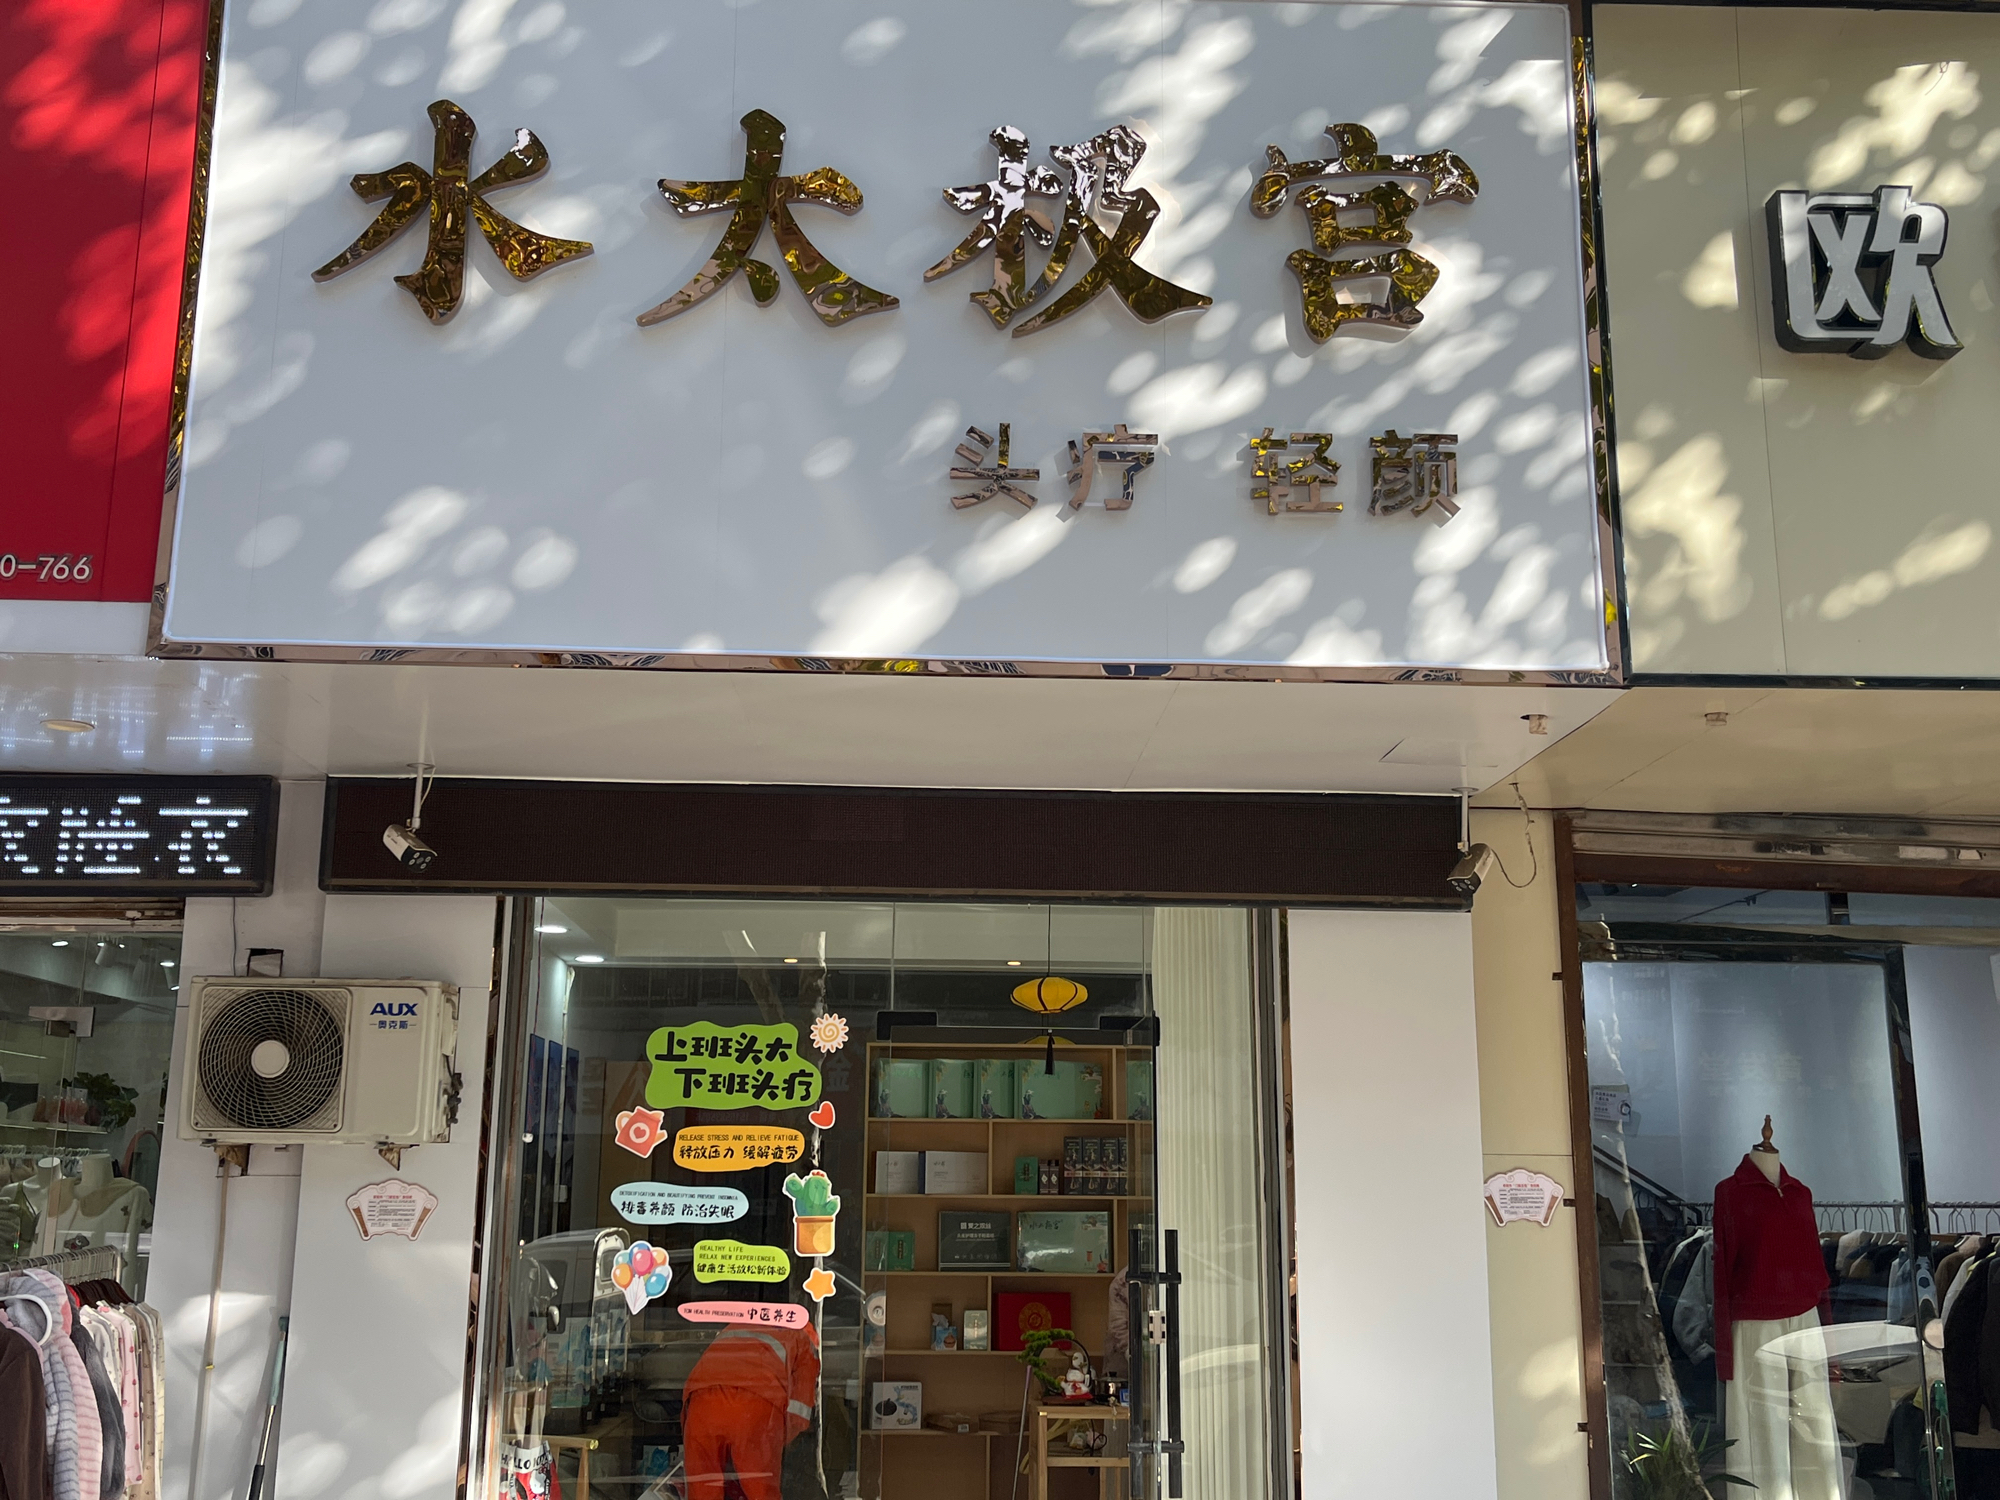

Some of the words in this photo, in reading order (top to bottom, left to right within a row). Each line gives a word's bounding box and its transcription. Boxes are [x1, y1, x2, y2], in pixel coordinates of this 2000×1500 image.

[311, 99, 1480, 343] 水太极宫
[1768, 185, 1964, 355] 欧
[949, 422, 1159, 511] 头疗
[1248, 427, 1460, 517] 轻颜
[370, 1002, 418, 1016] AUX
[655, 1031, 792, 1065] 上班头大
[674, 1069, 814, 1101] 下班头疗
[679, 1145, 734, 1159] 释放压力
[743, 1145, 798, 1159] 缓解疲劳
[621, 1200, 675, 1216] 排毒养颜
[681, 1203, 734, 1218] 防治失眠
[697, 1263, 787, 1275] 健康生活放松新体验
[748, 1307, 796, 1322] 中医养生
